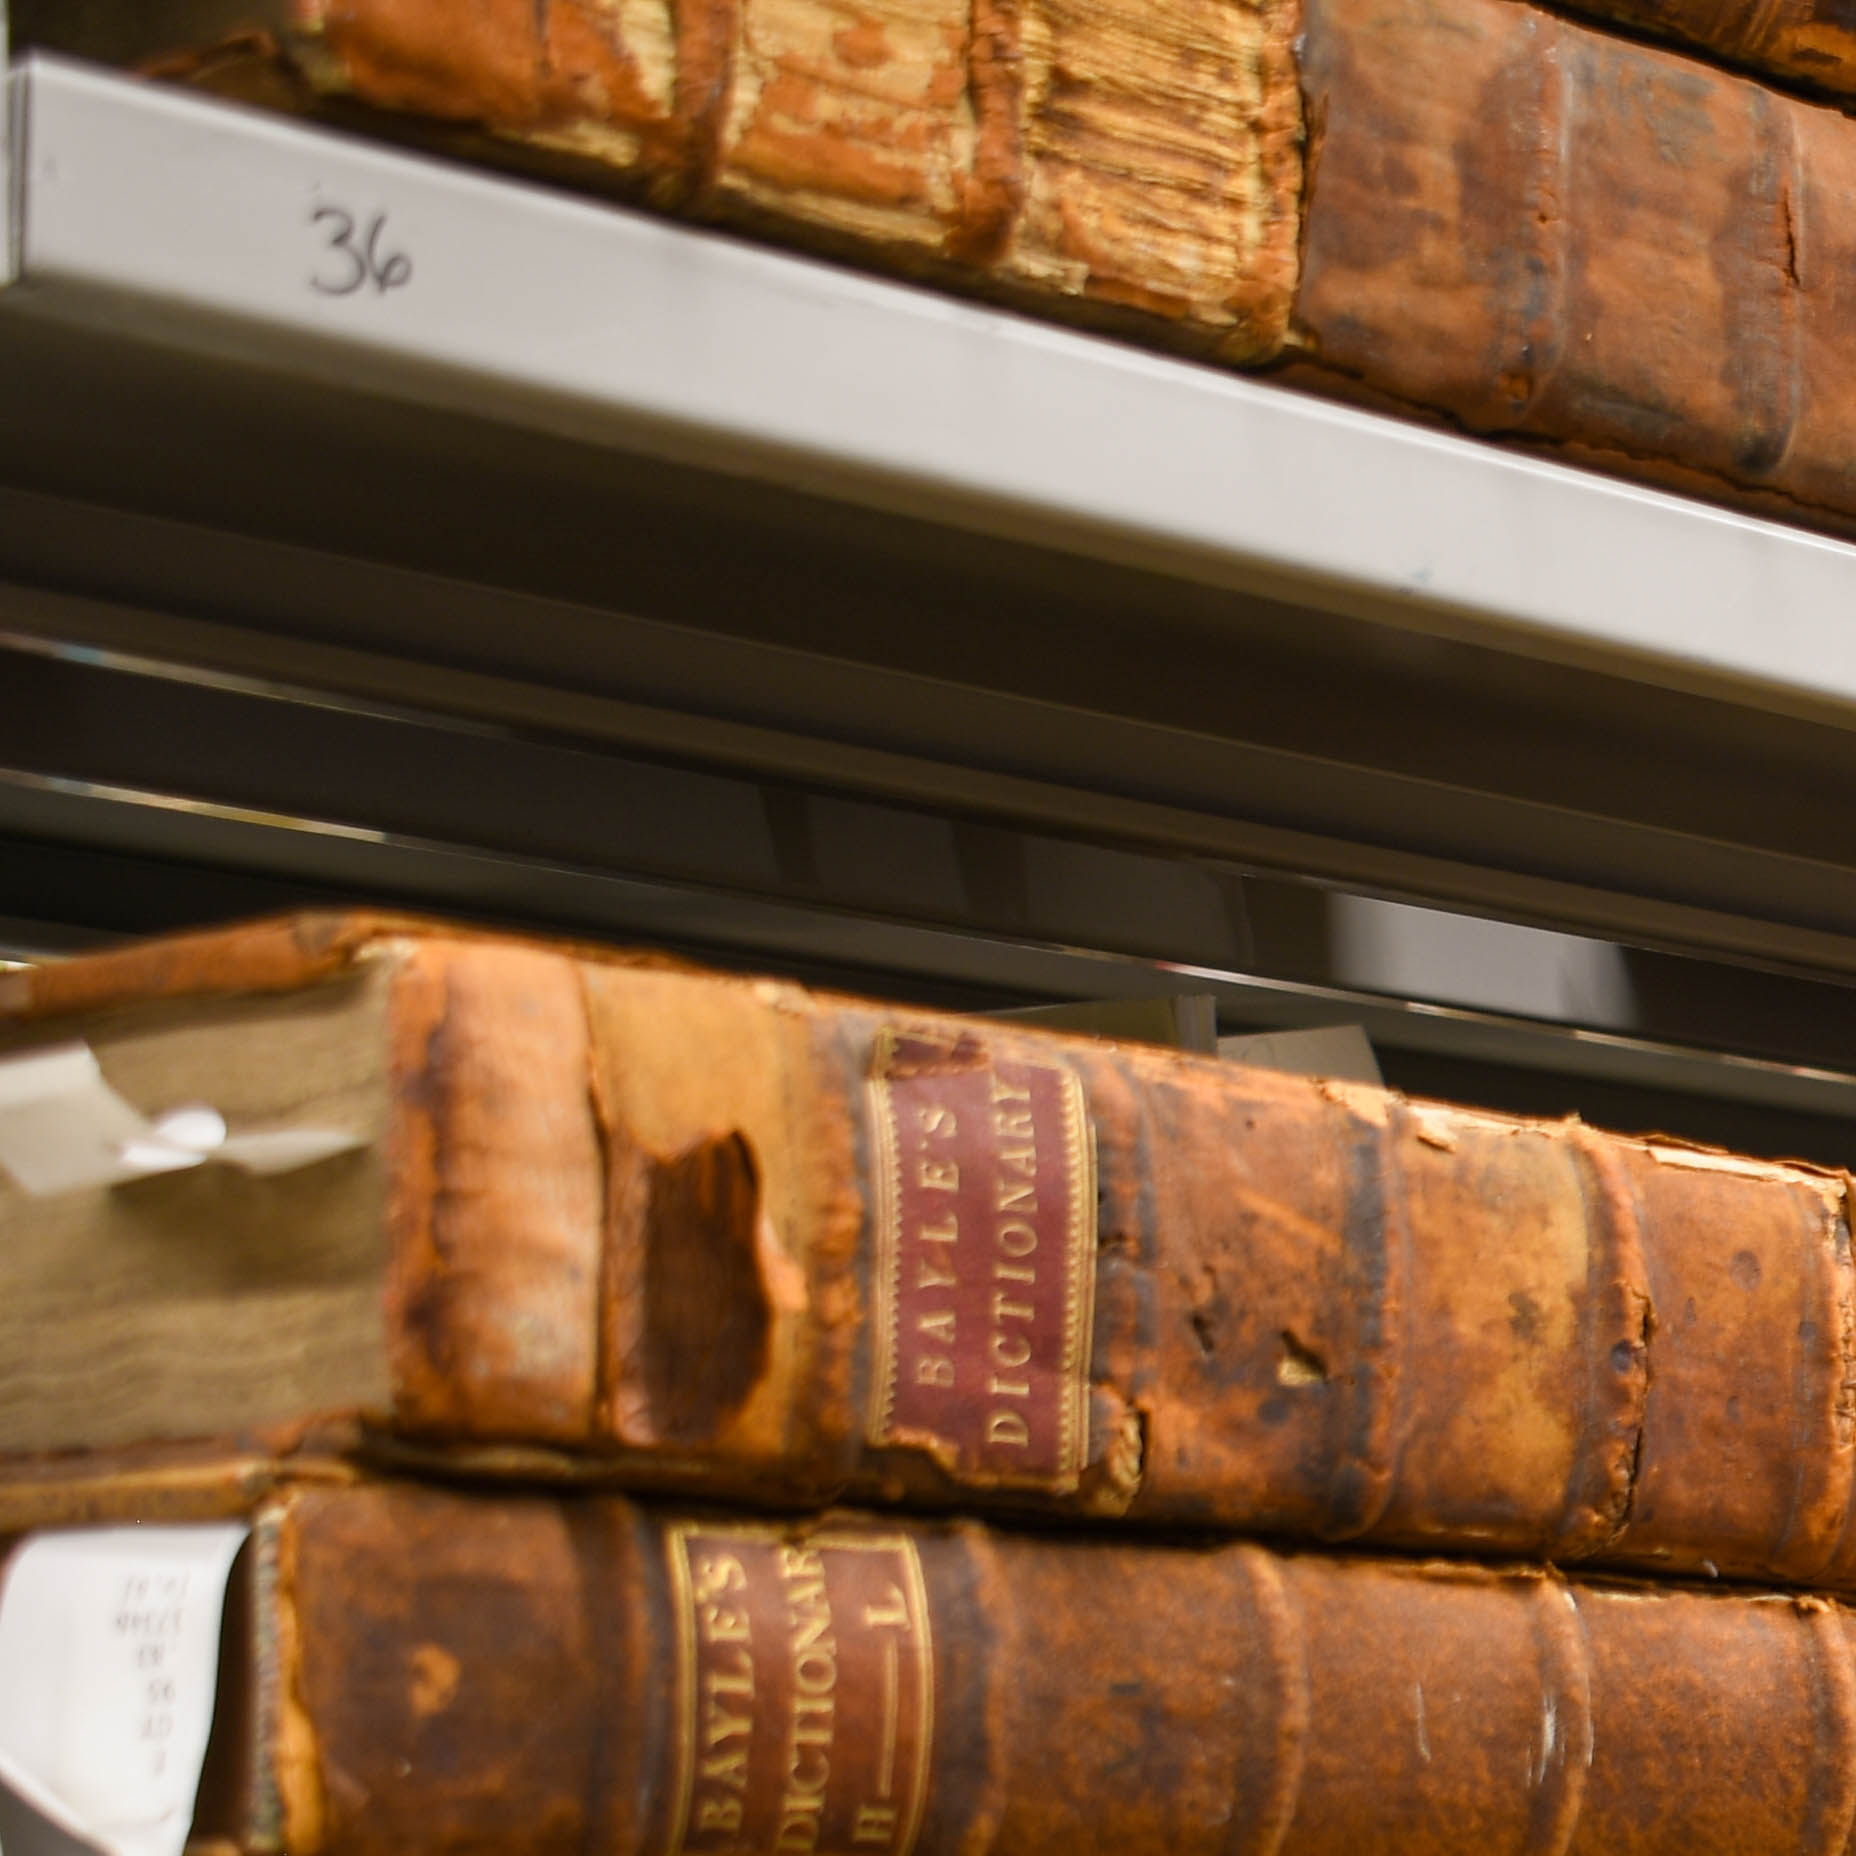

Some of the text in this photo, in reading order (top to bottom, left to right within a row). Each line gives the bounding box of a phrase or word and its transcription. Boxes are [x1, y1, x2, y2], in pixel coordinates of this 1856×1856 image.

[309, 206, 412, 297] 36
[916, 1102, 961, 1389] BAYLE'S
[986, 1078, 1040, 1448] DICTIONARY
